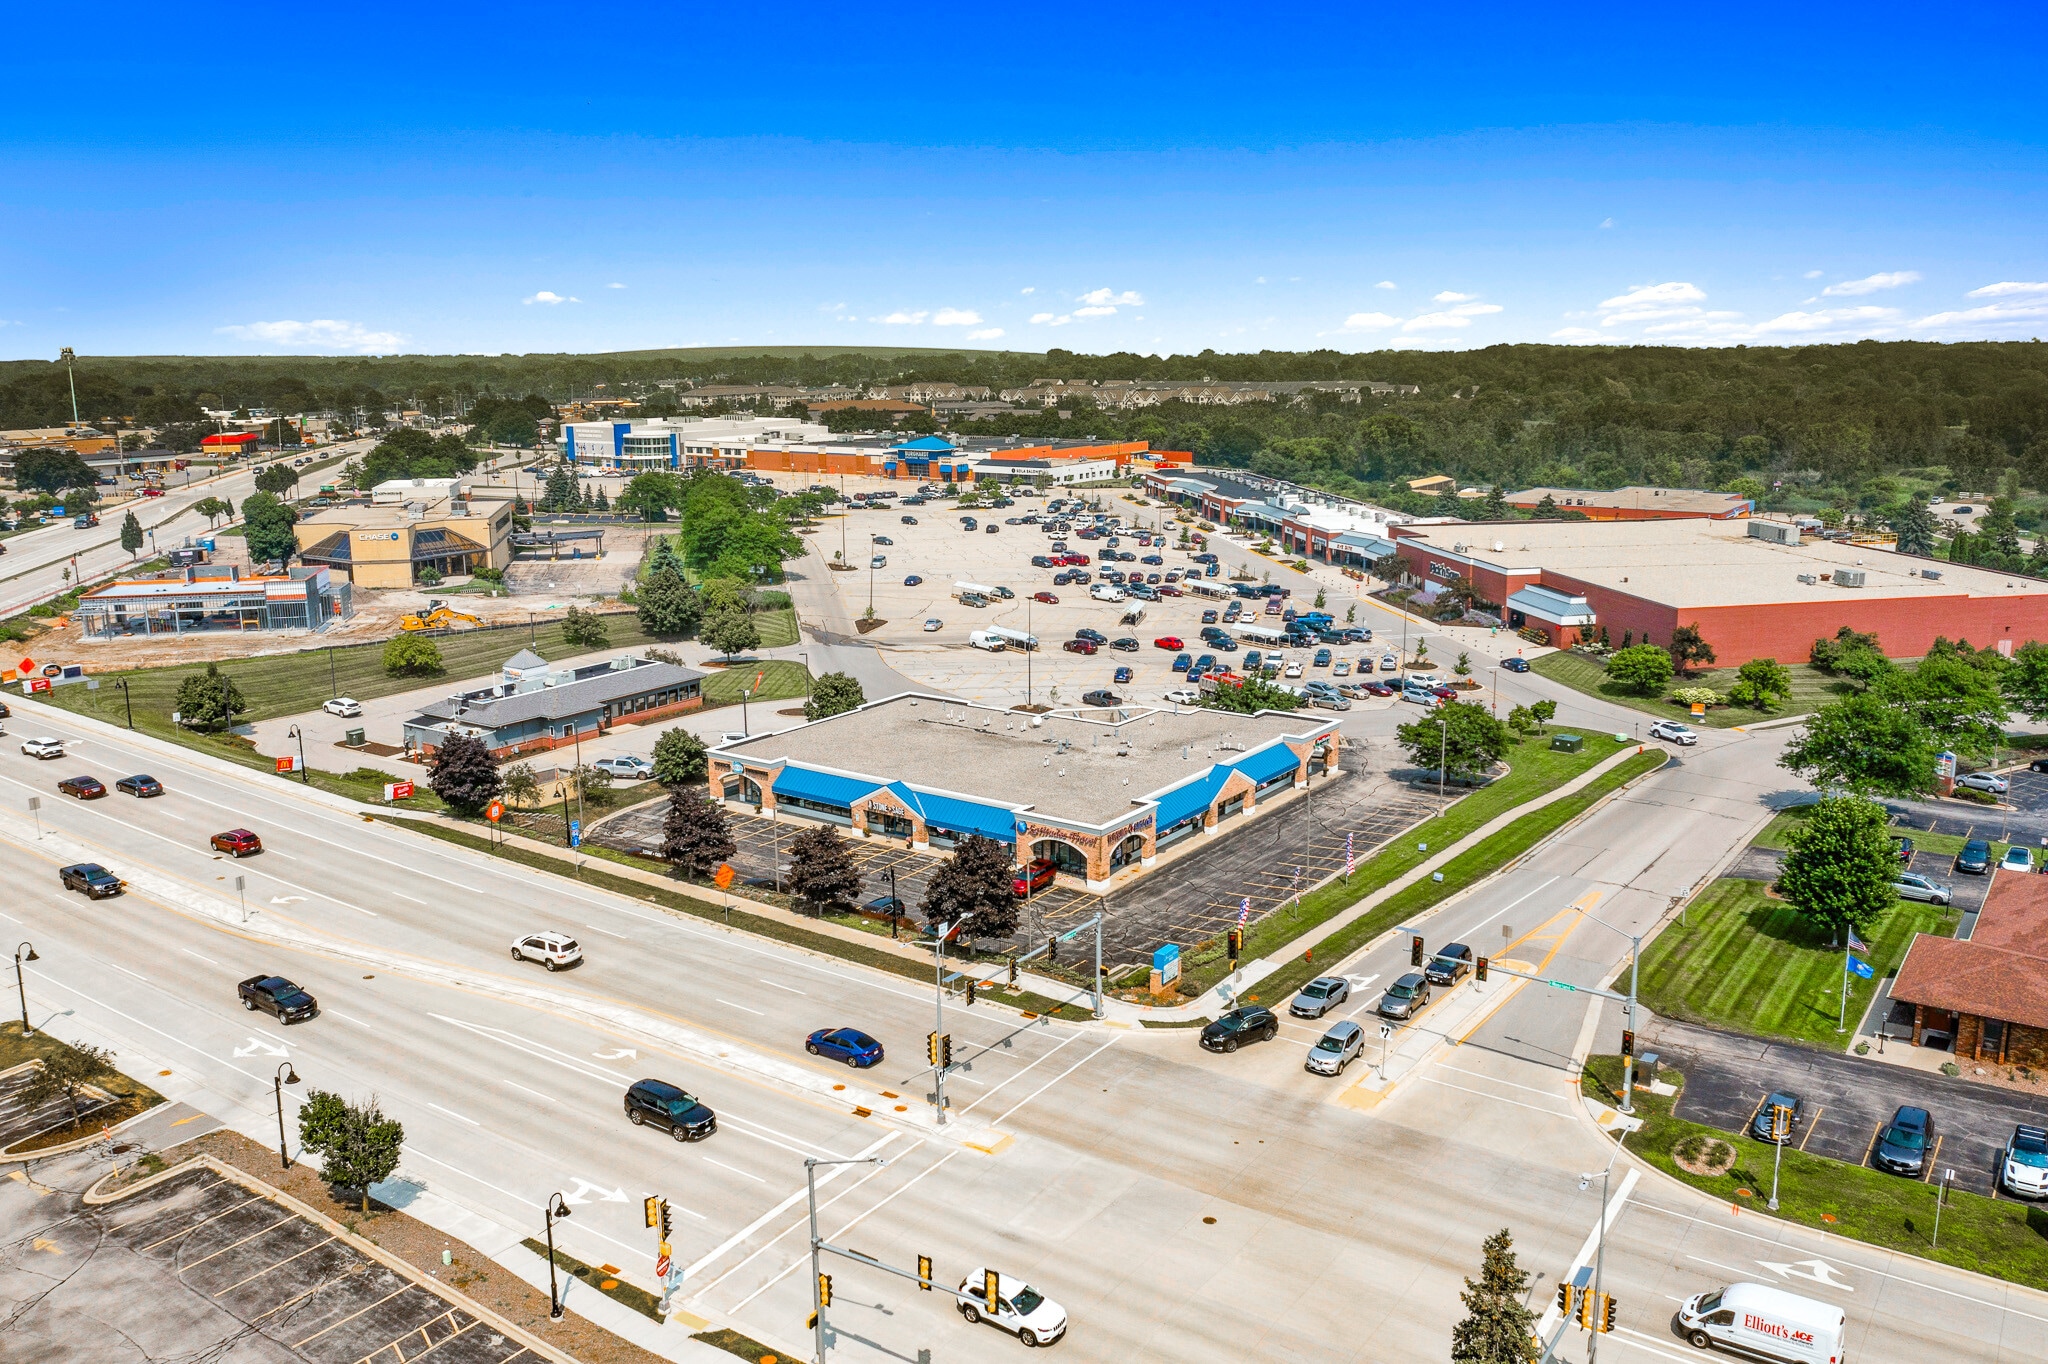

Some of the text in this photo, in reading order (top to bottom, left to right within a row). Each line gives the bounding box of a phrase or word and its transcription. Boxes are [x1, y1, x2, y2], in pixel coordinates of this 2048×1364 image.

[359, 533, 389, 541] CHASE
[1744, 1314, 1789, 1339] Elliott's
[1791, 1330, 1814, 1342] ACE
